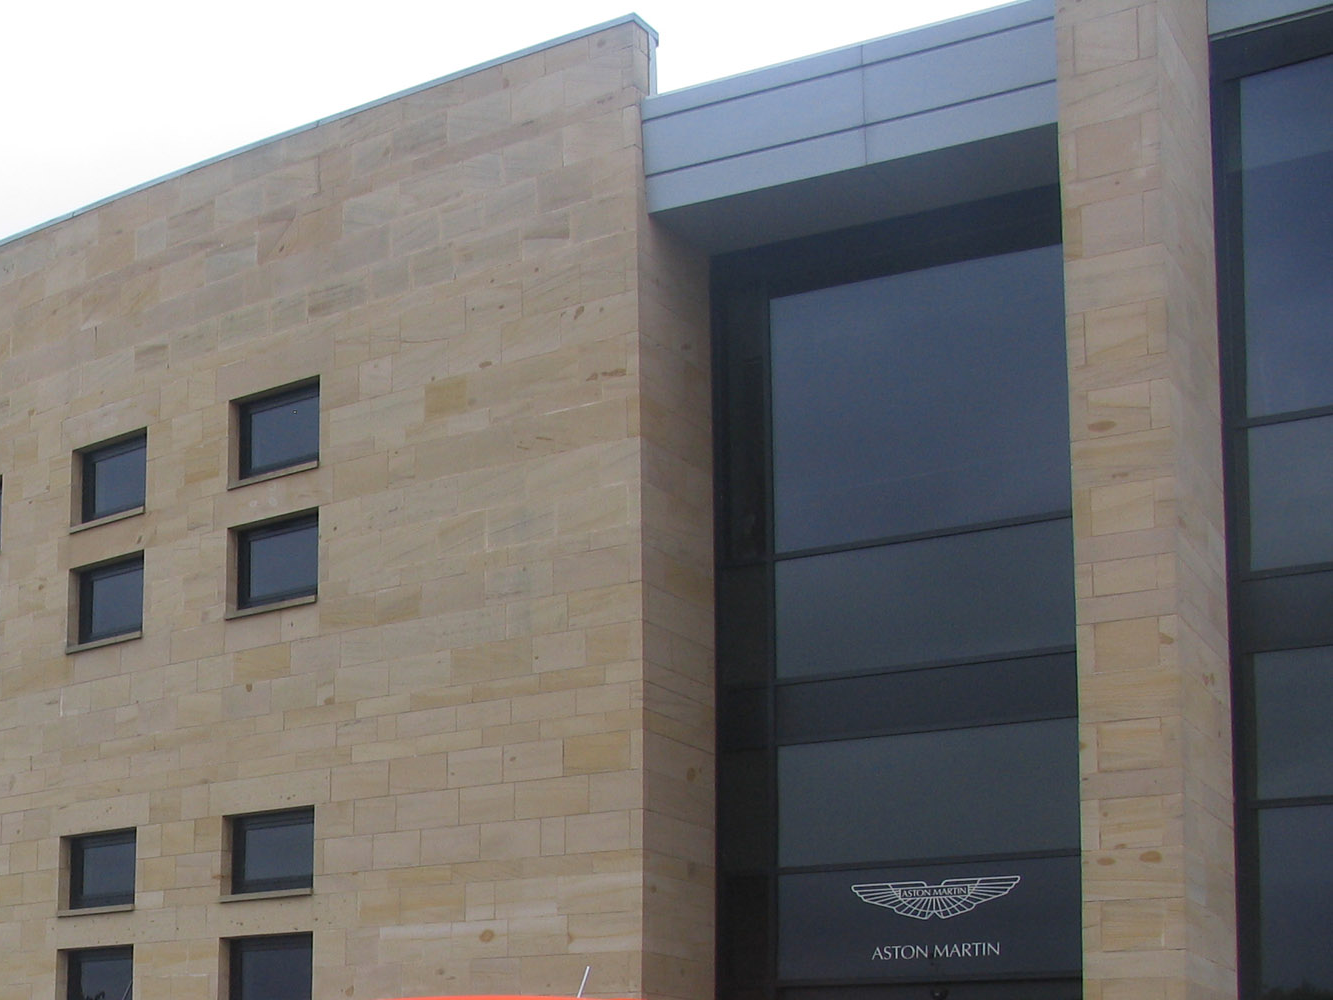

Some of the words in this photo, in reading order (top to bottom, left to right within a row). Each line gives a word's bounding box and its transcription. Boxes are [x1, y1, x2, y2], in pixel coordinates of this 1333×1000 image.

[901, 888, 931, 898] ASTON
[932, 887, 967, 897] MARTIN
[872, 944, 928, 960] ASTON
[933, 942, 1000, 959] MARTIN
